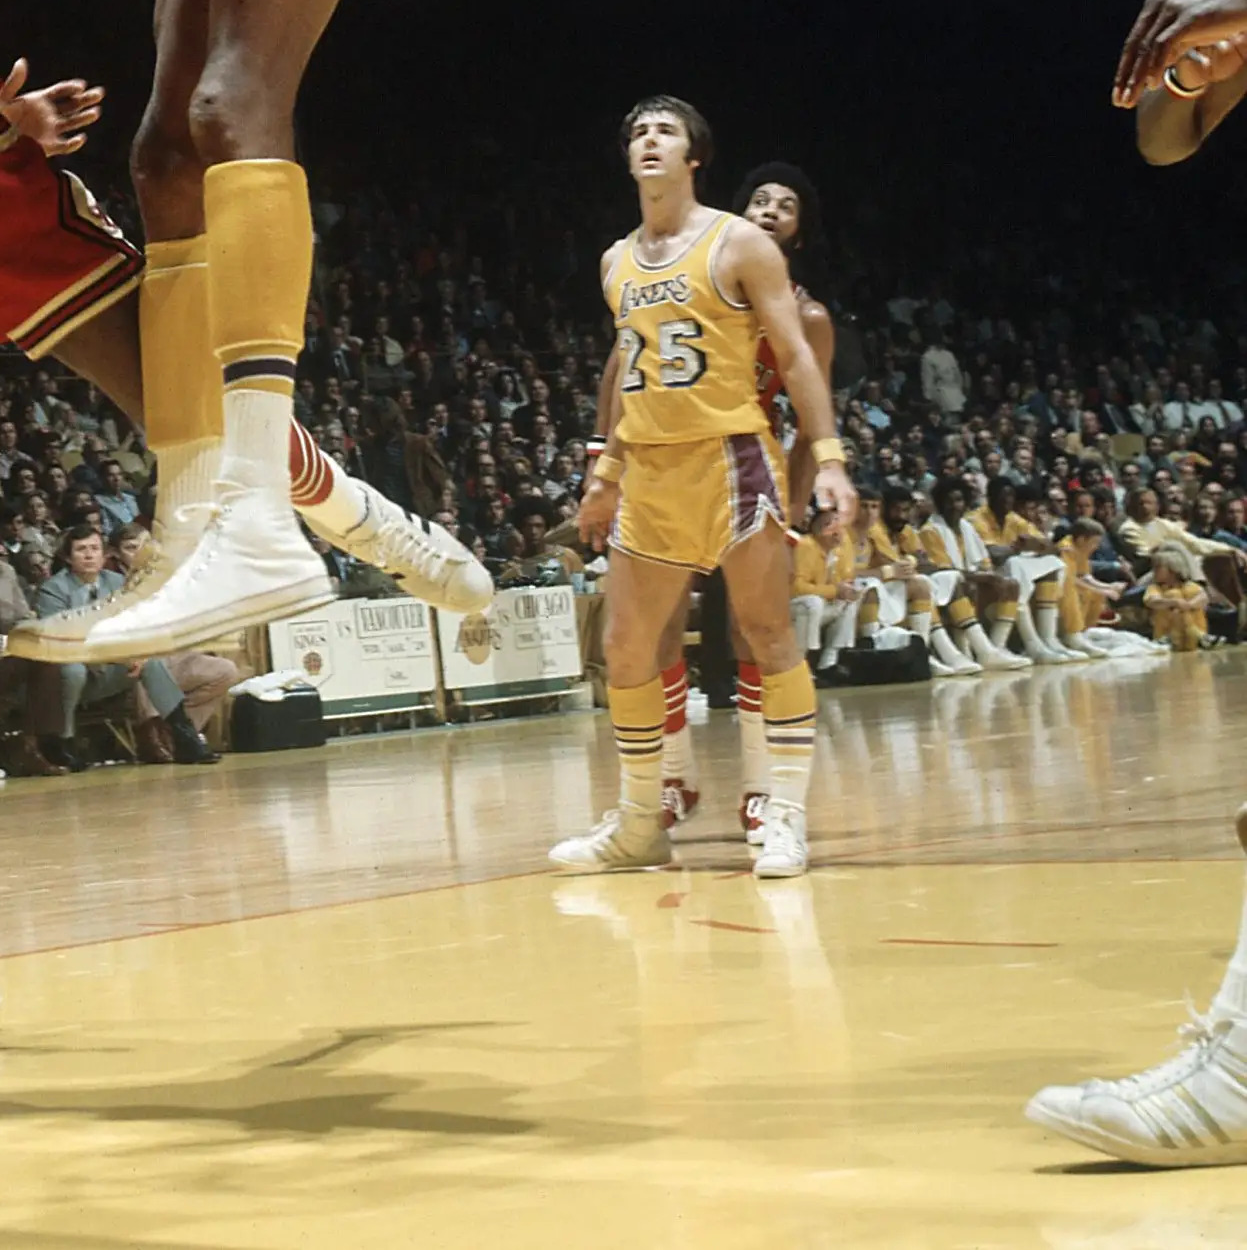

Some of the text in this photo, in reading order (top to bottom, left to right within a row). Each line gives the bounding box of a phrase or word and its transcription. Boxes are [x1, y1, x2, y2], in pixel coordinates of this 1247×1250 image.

[616, 274, 691, 321] LAKERS
[616, 317, 707, 393] 25
[514, 591, 570, 620] CHICAGO
